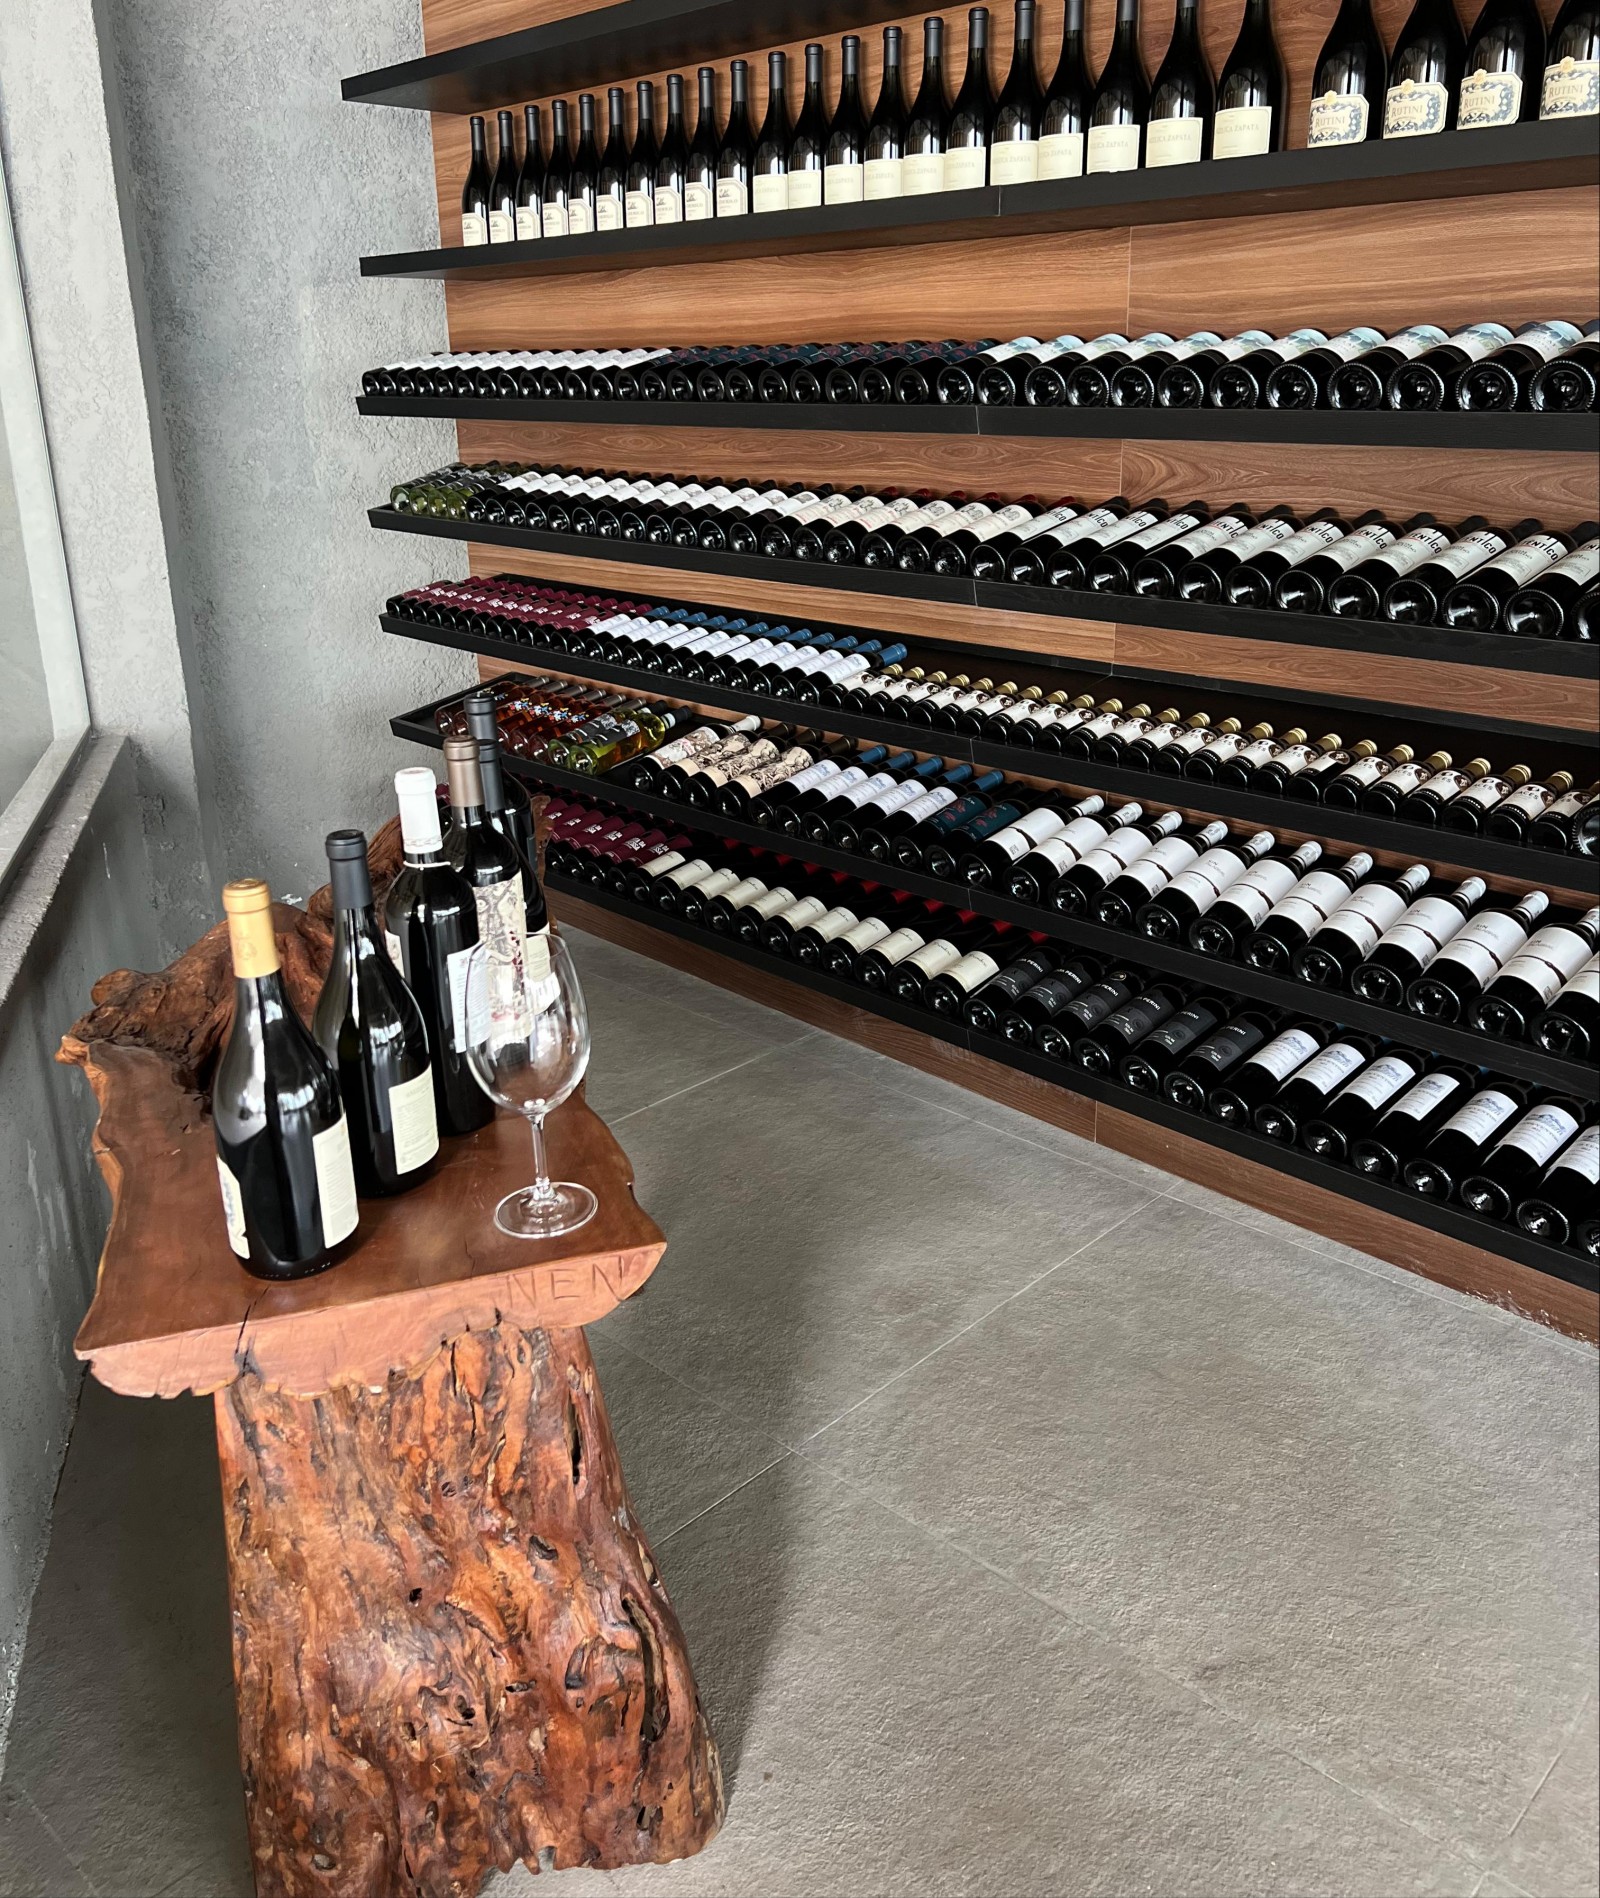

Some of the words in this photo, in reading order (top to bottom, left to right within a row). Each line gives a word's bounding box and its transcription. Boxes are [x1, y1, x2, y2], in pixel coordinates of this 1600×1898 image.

[1547, 84, 1583, 99] RUTINI
[1463, 95, 1496, 110] RUTINI
[1391, 105, 1423, 117] RUTINI
[1315, 116, 1345, 128] RUTINI
